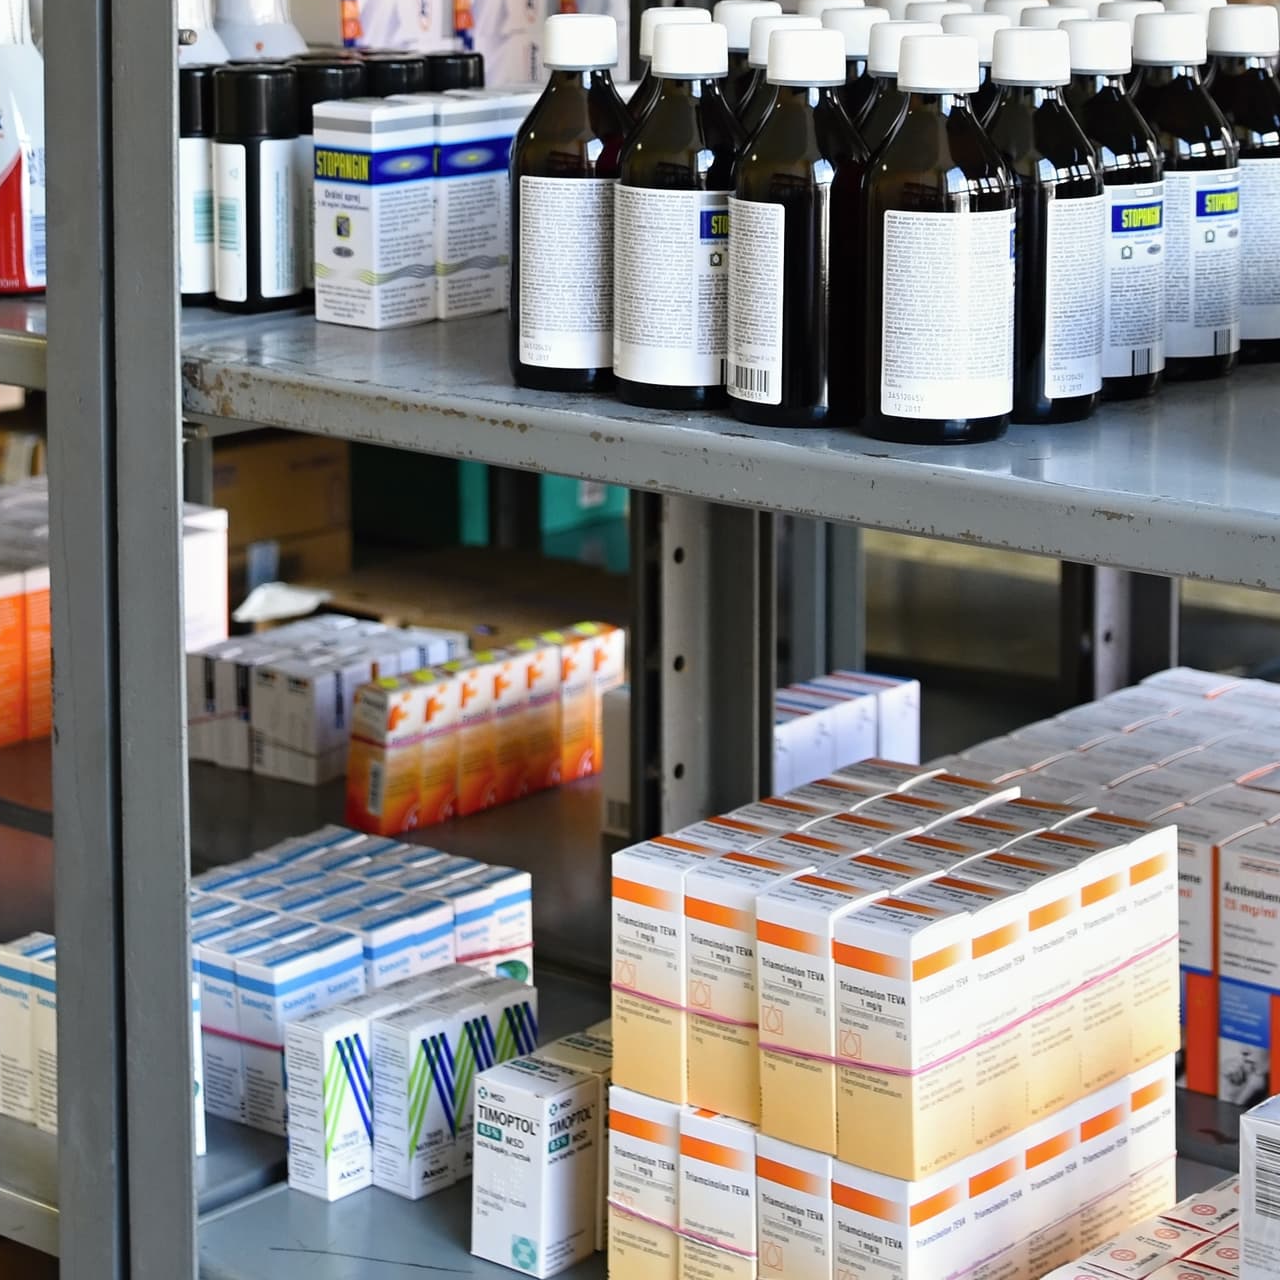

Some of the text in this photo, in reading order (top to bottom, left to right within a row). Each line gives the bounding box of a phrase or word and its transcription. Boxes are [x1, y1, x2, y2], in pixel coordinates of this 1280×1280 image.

[316, 150, 369, 181] STOPANGIN
[761, 957, 825, 983] Triamcinolon TEVA
[282, 992, 317, 1011] Sanorin
[839, 980, 907, 1006] Triamcinolon TEVA
[478, 1104, 537, 1137] TIMOPTOL
[549, 1106, 592, 1137] TIMOPTOL
